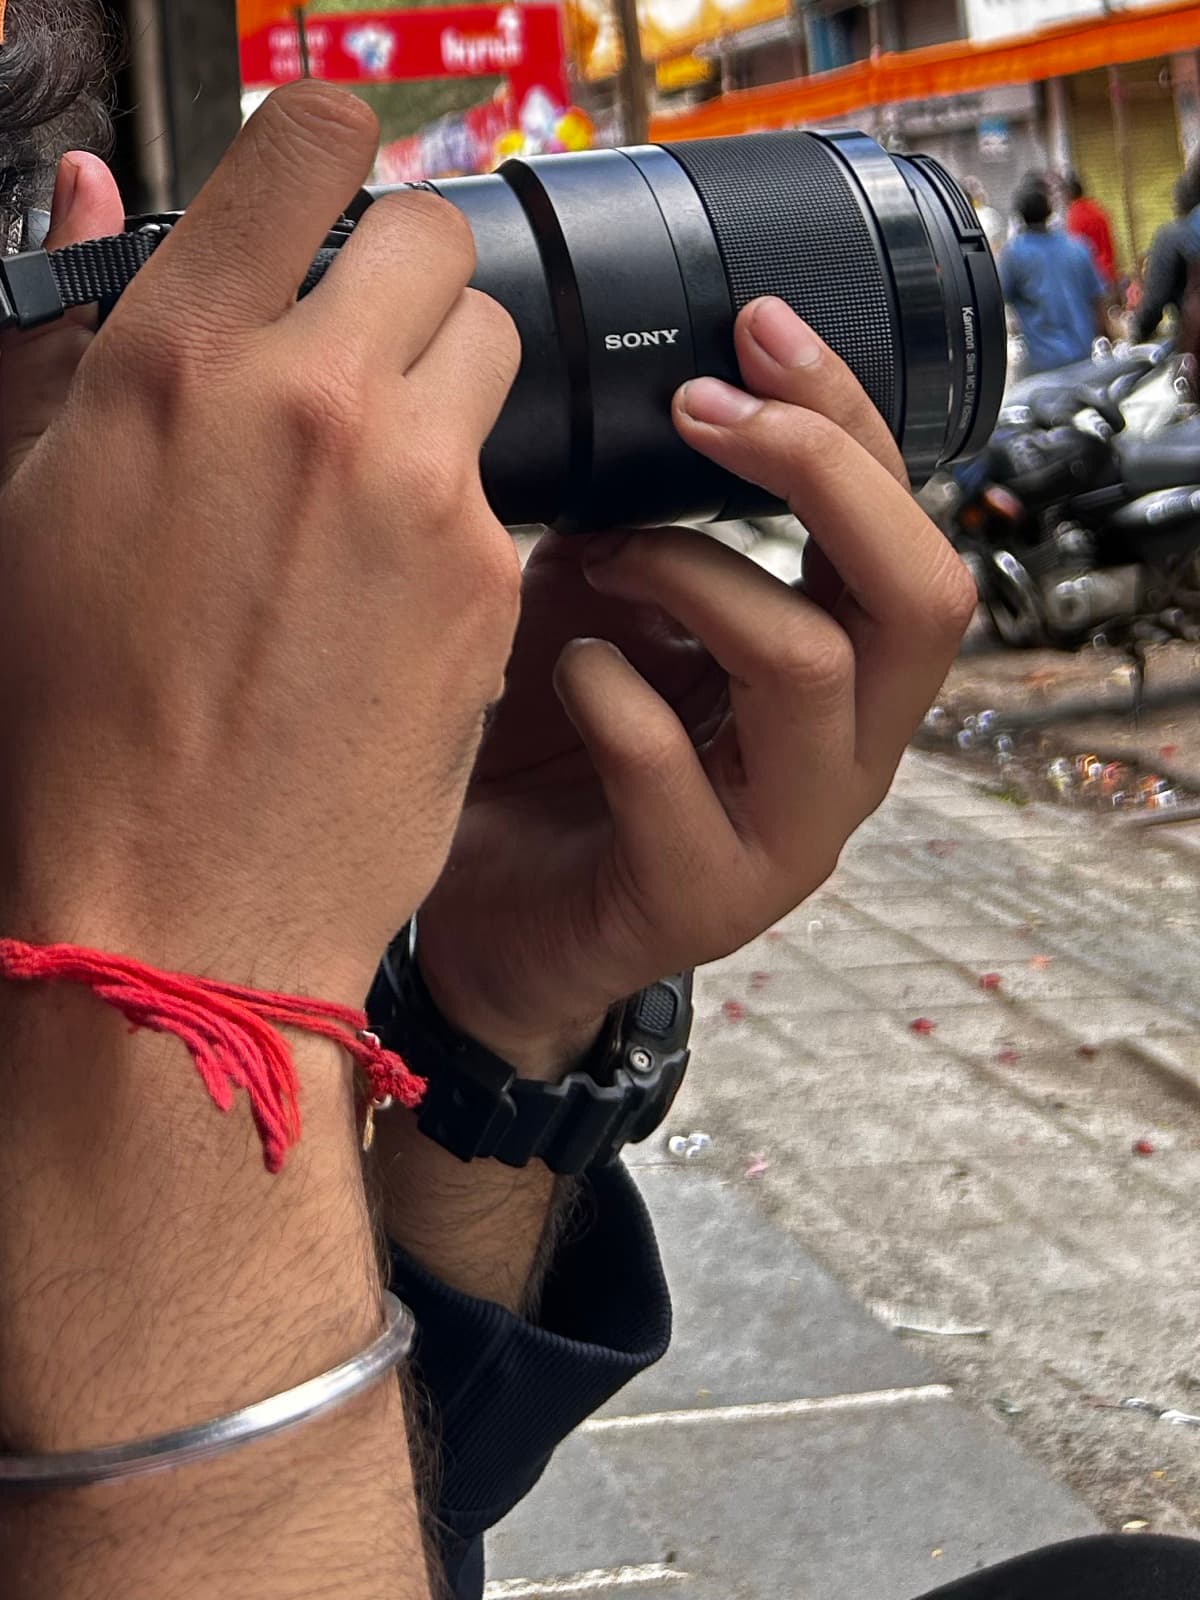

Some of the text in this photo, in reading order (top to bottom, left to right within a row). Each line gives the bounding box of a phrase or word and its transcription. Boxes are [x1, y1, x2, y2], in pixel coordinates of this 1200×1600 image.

[961, 305, 975, 350] Kamron
[604, 328, 680, 350] SONY
[965, 352, 976, 373] Slim
